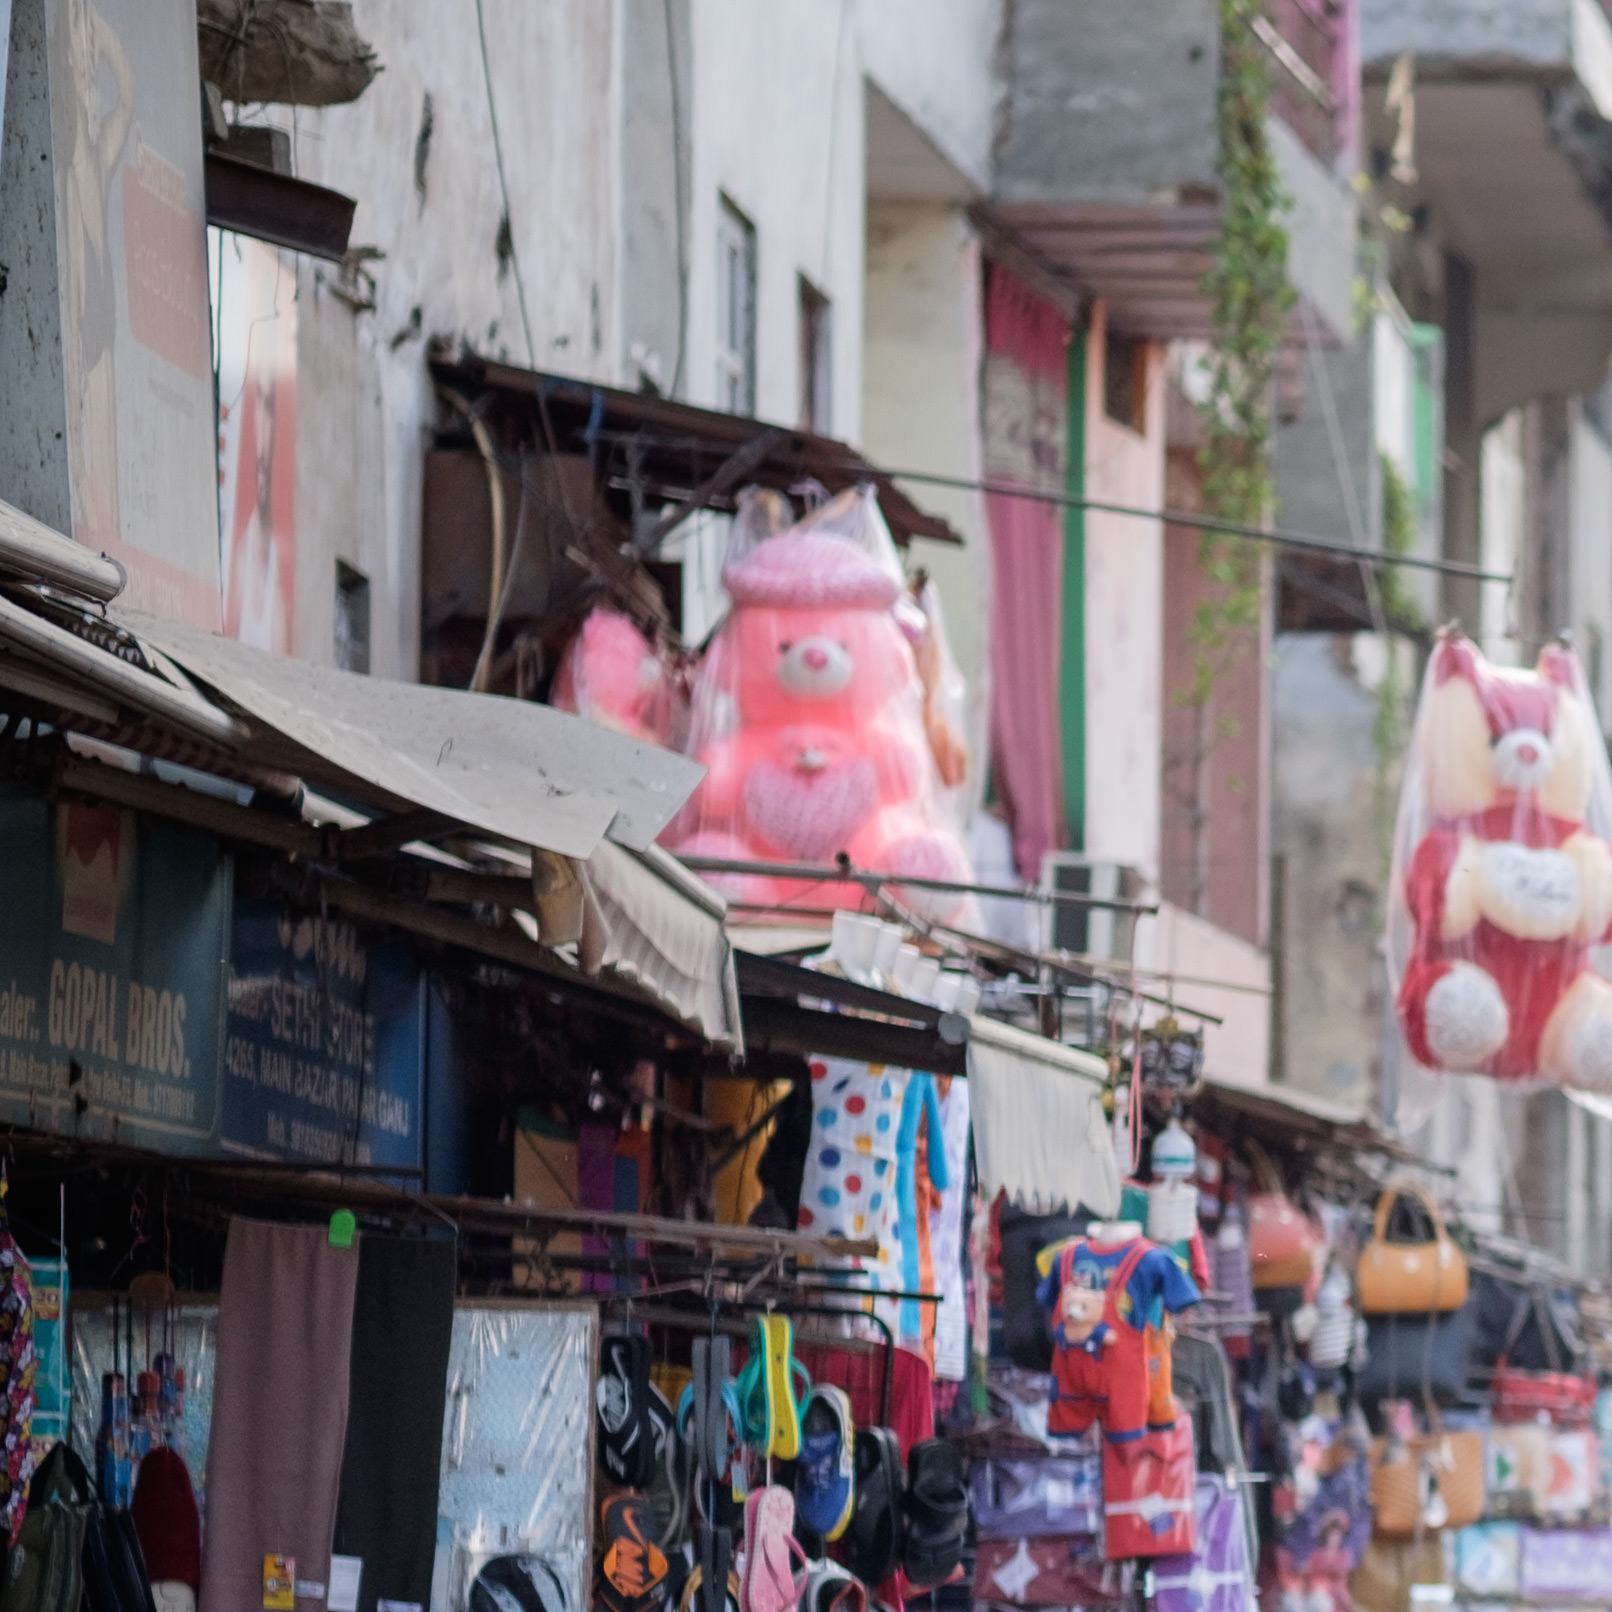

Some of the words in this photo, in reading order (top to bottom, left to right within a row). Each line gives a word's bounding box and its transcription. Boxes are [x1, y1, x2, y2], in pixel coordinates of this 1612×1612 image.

[48, 958, 119, 1061] GOPAL
[125, 981, 191, 1079] BROS.
[260, 1048, 292, 1095] MAIN
[378, 1088, 409, 1138] GANJ
